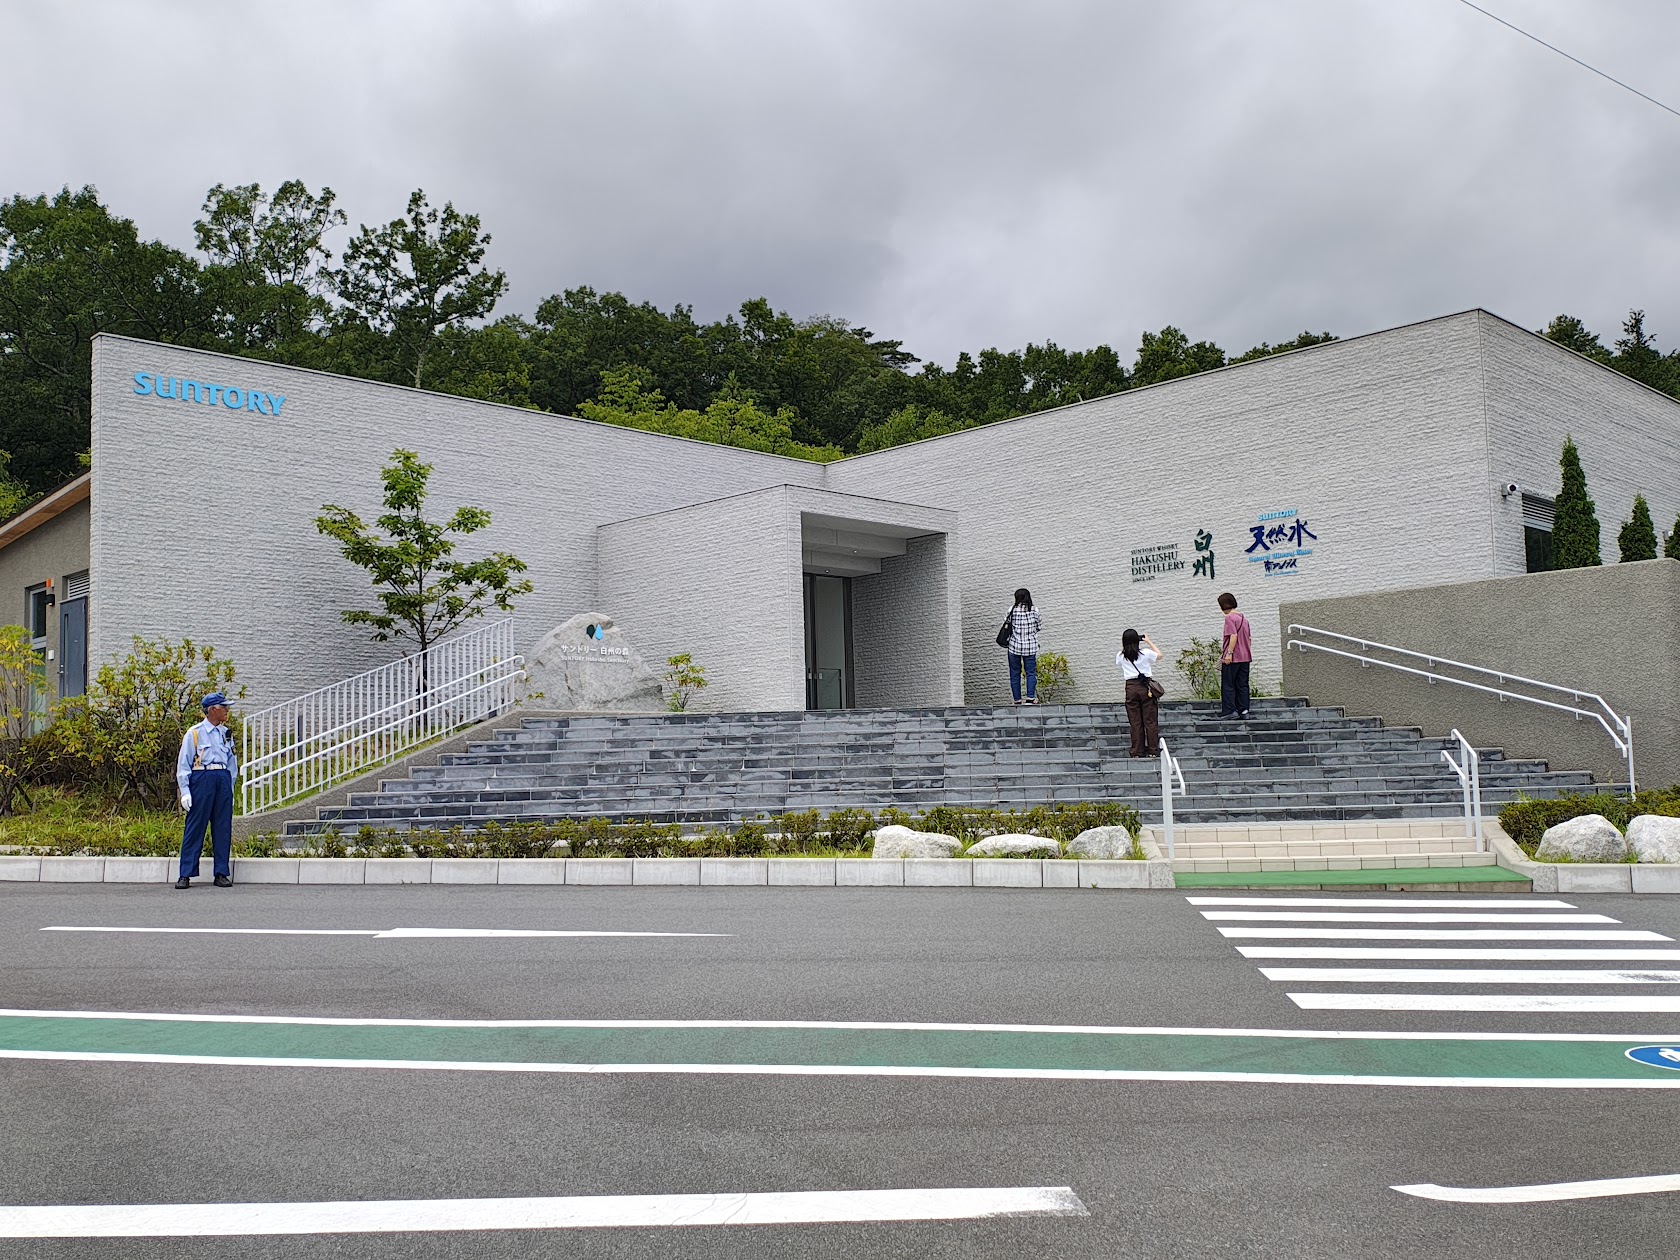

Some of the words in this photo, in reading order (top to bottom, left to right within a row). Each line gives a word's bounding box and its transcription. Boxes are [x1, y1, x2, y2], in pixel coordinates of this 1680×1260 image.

[133, 371, 287, 416] SUNTORY
[1257, 508, 1299, 522] SUNTORY
[1245, 518, 1318, 553] 天然水
[1131, 551, 1179, 566] HAKUSHU
[1192, 528, 1215, 580] 白州
[1131, 560, 1186, 576] DISTILLERY
[561, 644, 598, 654] サントリー
[600, 645, 630, 656] 白州の森
